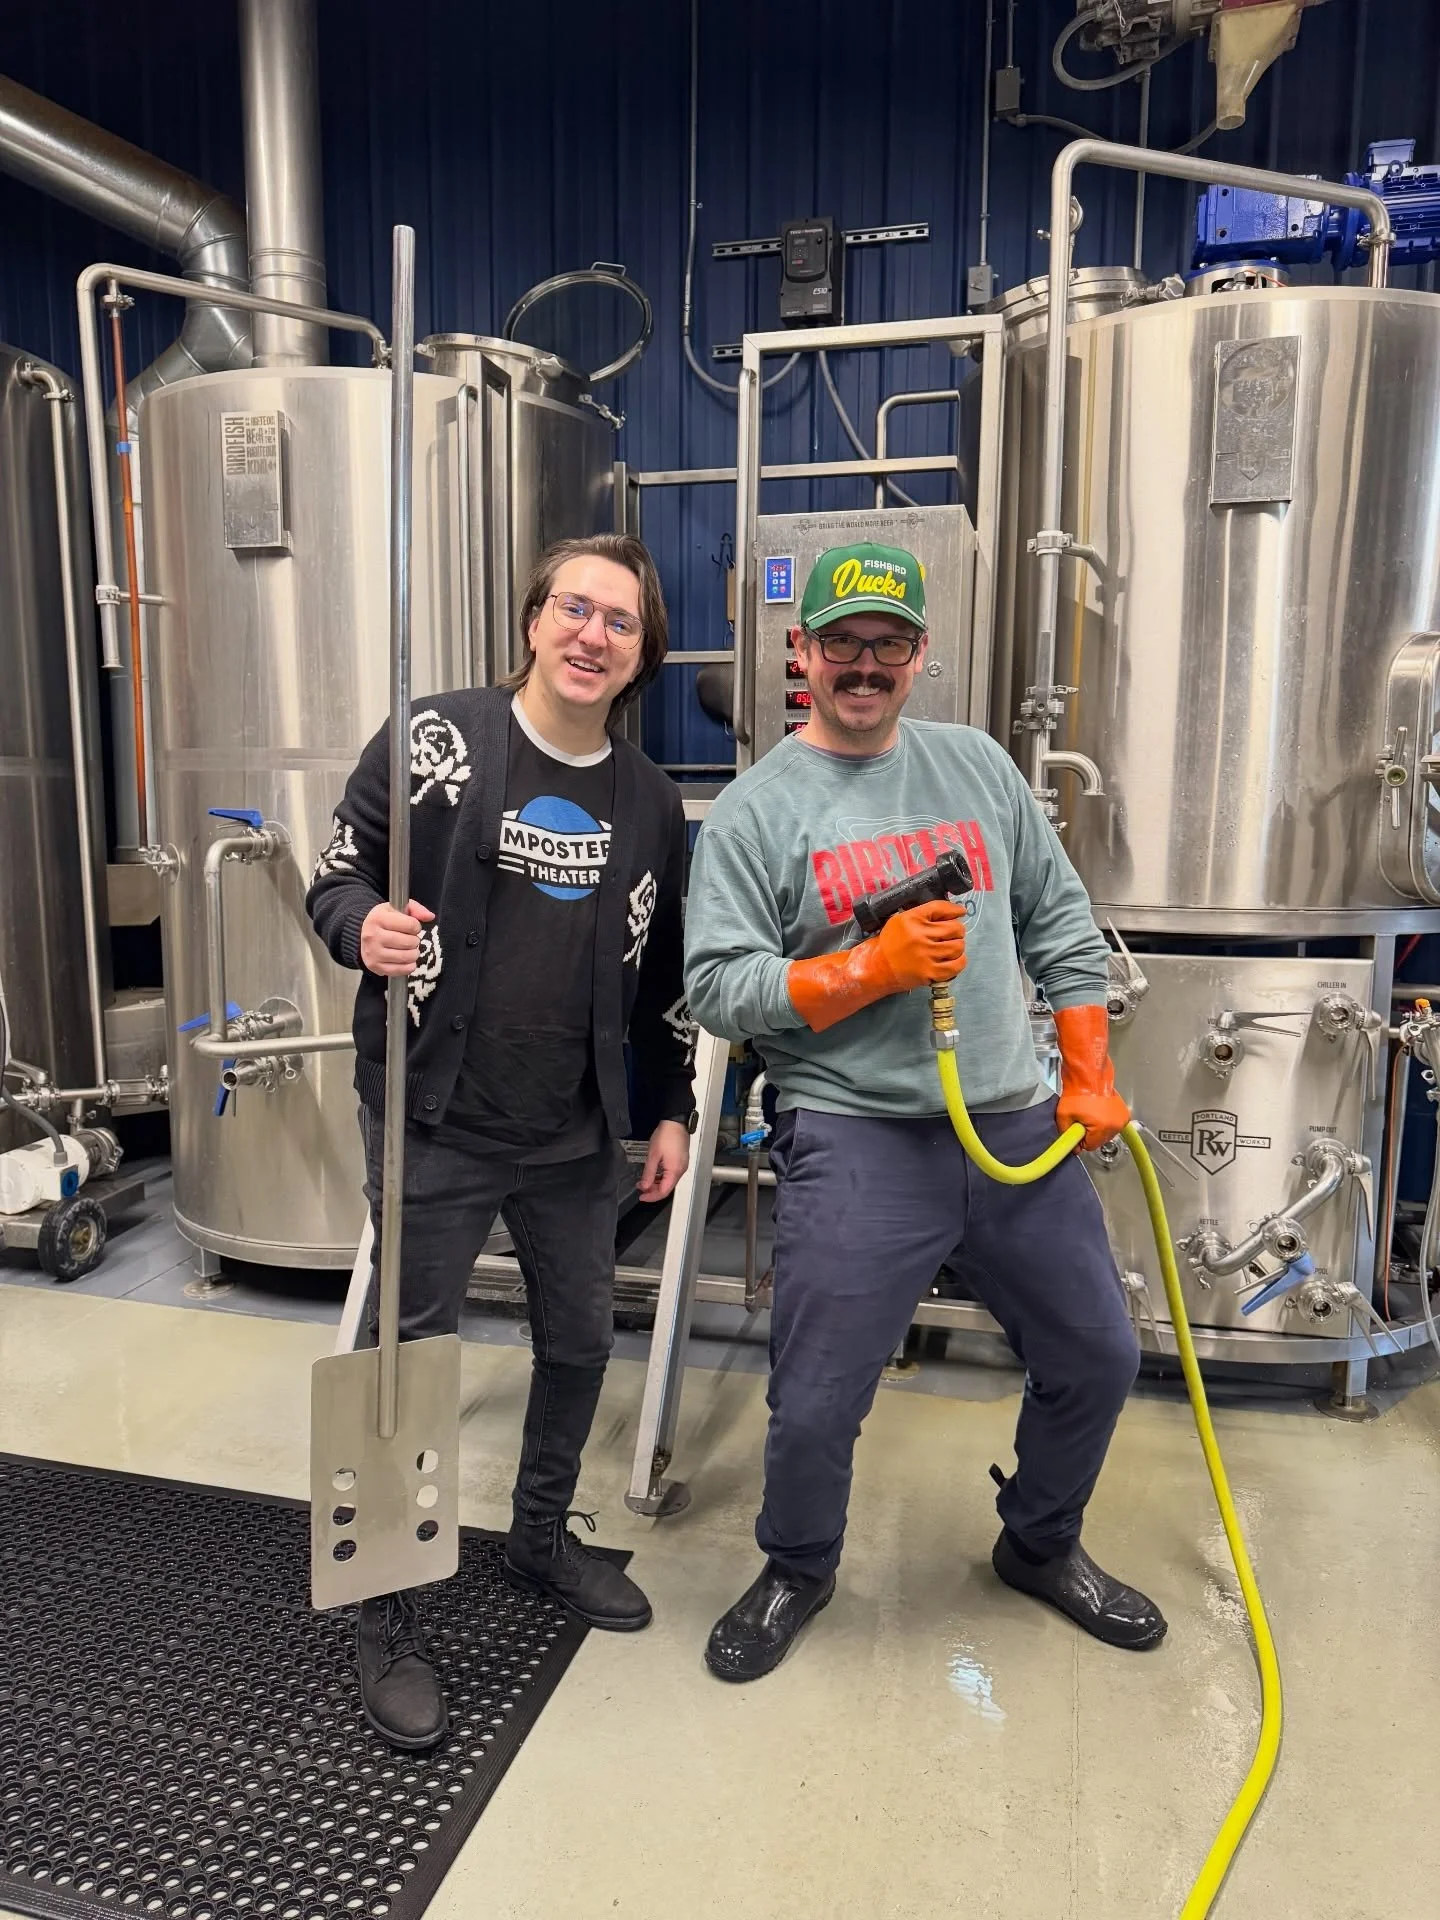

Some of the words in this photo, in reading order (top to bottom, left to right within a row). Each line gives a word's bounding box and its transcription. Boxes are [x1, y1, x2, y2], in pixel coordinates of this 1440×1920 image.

[225, 417, 246, 475] BIRDFISH
[864, 559, 907, 575] FISHBIRD
[832, 558, 907, 599] Ducks
[527, 862, 600, 885] THEATER
[1317, 981, 1339, 989] CHILLER
[1340, 981, 1347, 989] IN
[1196, 1112, 1234, 1122] PORTLAND
[1309, 1125, 1326, 1133] PUMP
[1326, 1126, 1337, 1134] OUT
[1161, 1133, 1190, 1141] KETTLE
[1239, 1138, 1266, 1146] WORKS
[1199, 1218, 1219, 1226] KETTLE
